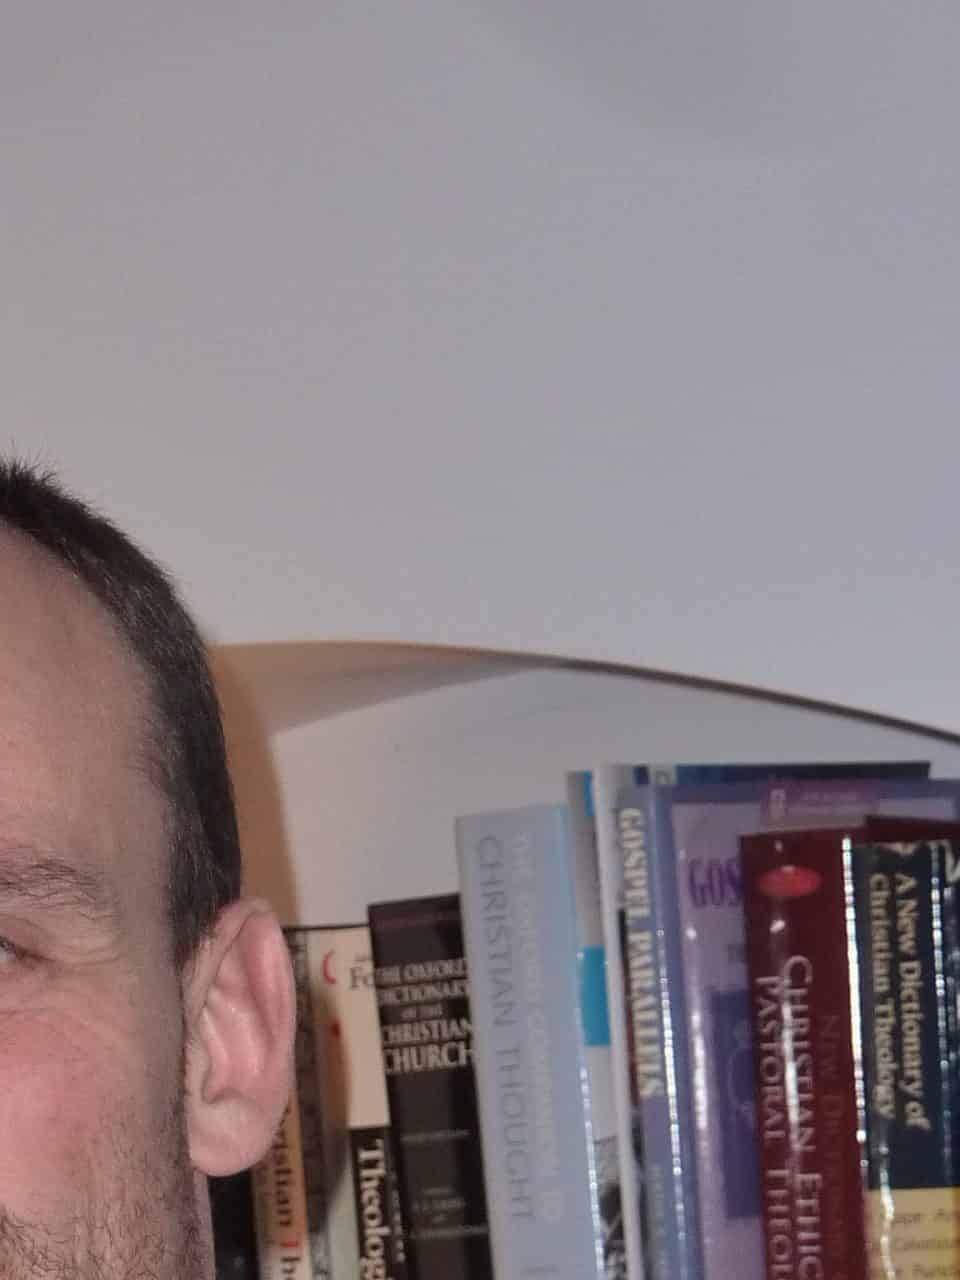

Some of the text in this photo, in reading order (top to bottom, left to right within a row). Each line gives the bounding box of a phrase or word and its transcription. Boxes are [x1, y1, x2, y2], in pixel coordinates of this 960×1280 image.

[477, 834, 518, 1027] CHRISTIAN
[622, 809, 663, 1098] GOSPEL PARALLELS
[869, 873, 899, 1119] Christian Theology
[896, 873, 931, 1132] A New Dictionary of
[382, 1017, 472, 1044] CHRISTIAN
[384, 1041, 472, 1075] CHURCH
[755, 976, 786, 1141] PASTORAL
[783, 955, 816, 1151] CHRISTIAN
[495, 1041, 533, 1221] THOUGHT
